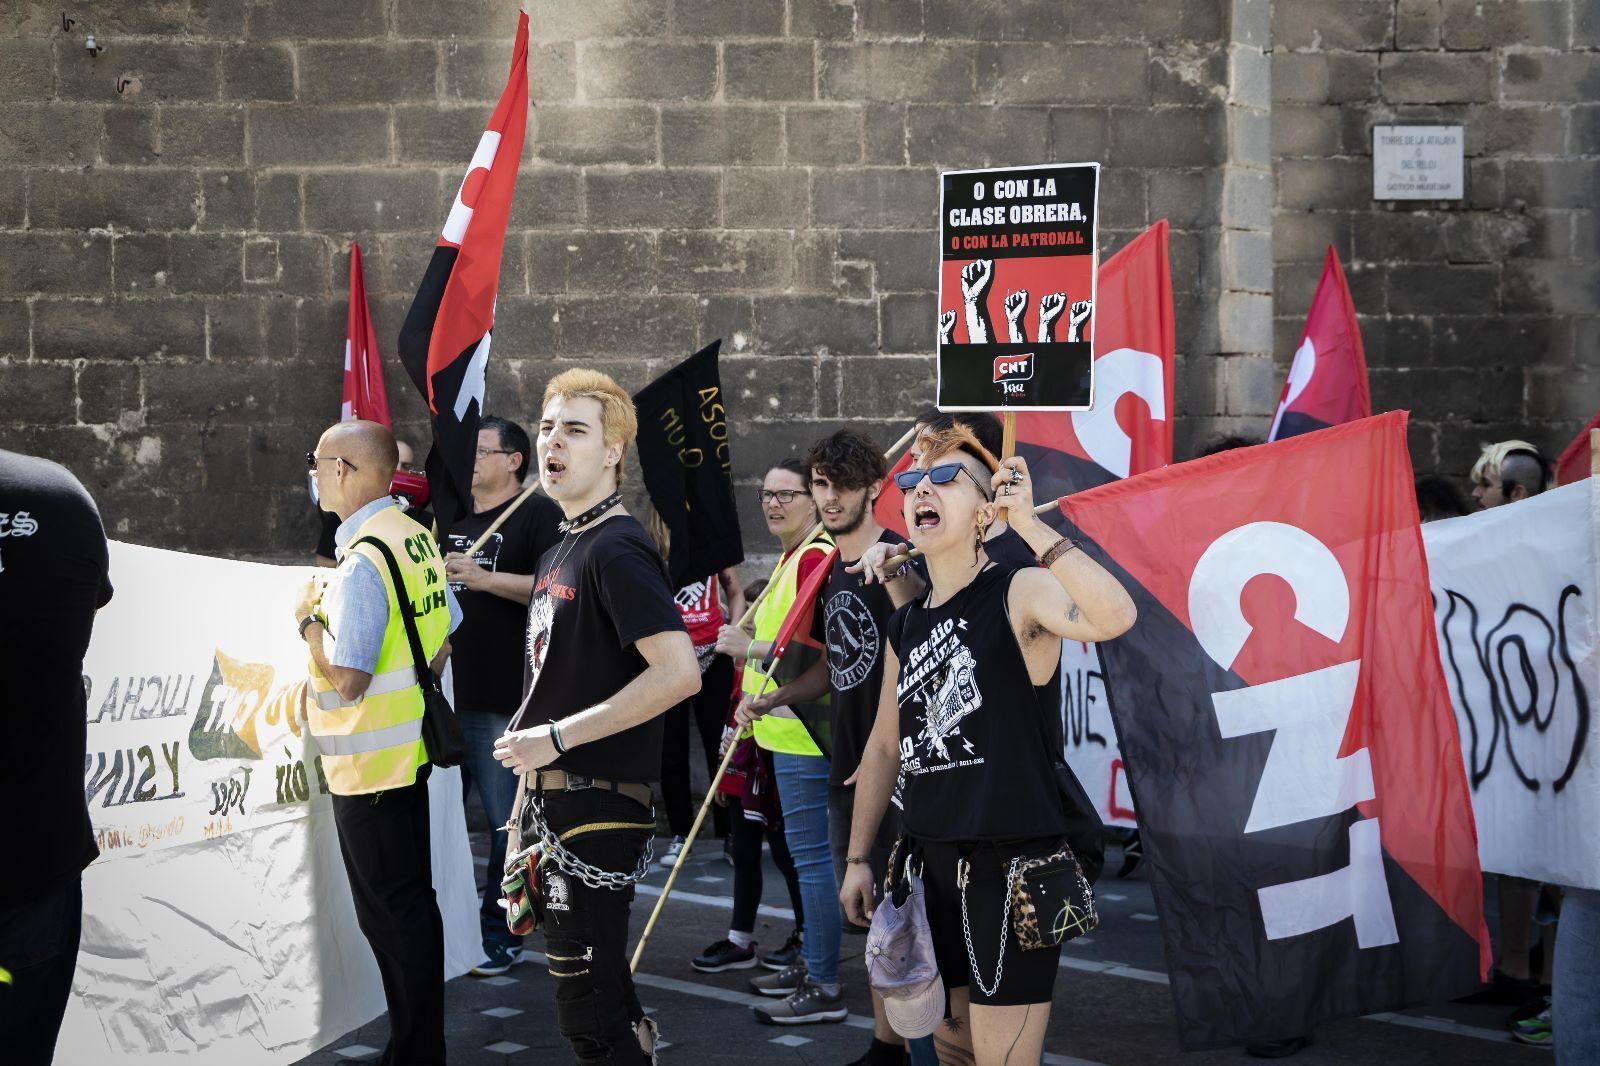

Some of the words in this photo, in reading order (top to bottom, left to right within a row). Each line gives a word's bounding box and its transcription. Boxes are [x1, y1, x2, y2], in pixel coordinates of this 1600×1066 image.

[973, 182, 985, 201] O
[994, 179, 1029, 200] CON
[1033, 178, 1057, 197] LA
[950, 207, 1006, 228] CLASE
[1009, 202, 1087, 225] OBRERA,
[951, 236, 960, 250] O
[963, 234, 989, 249] CON
[991, 233, 1009, 248] LA
[1012, 231, 1084, 247] PATRONAL
[999, 361, 1028, 374] CNT
[404, 532, 436, 564] CNT
[909, 618, 954, 669] Radio
[1187, 521, 1400, 949] CNT
